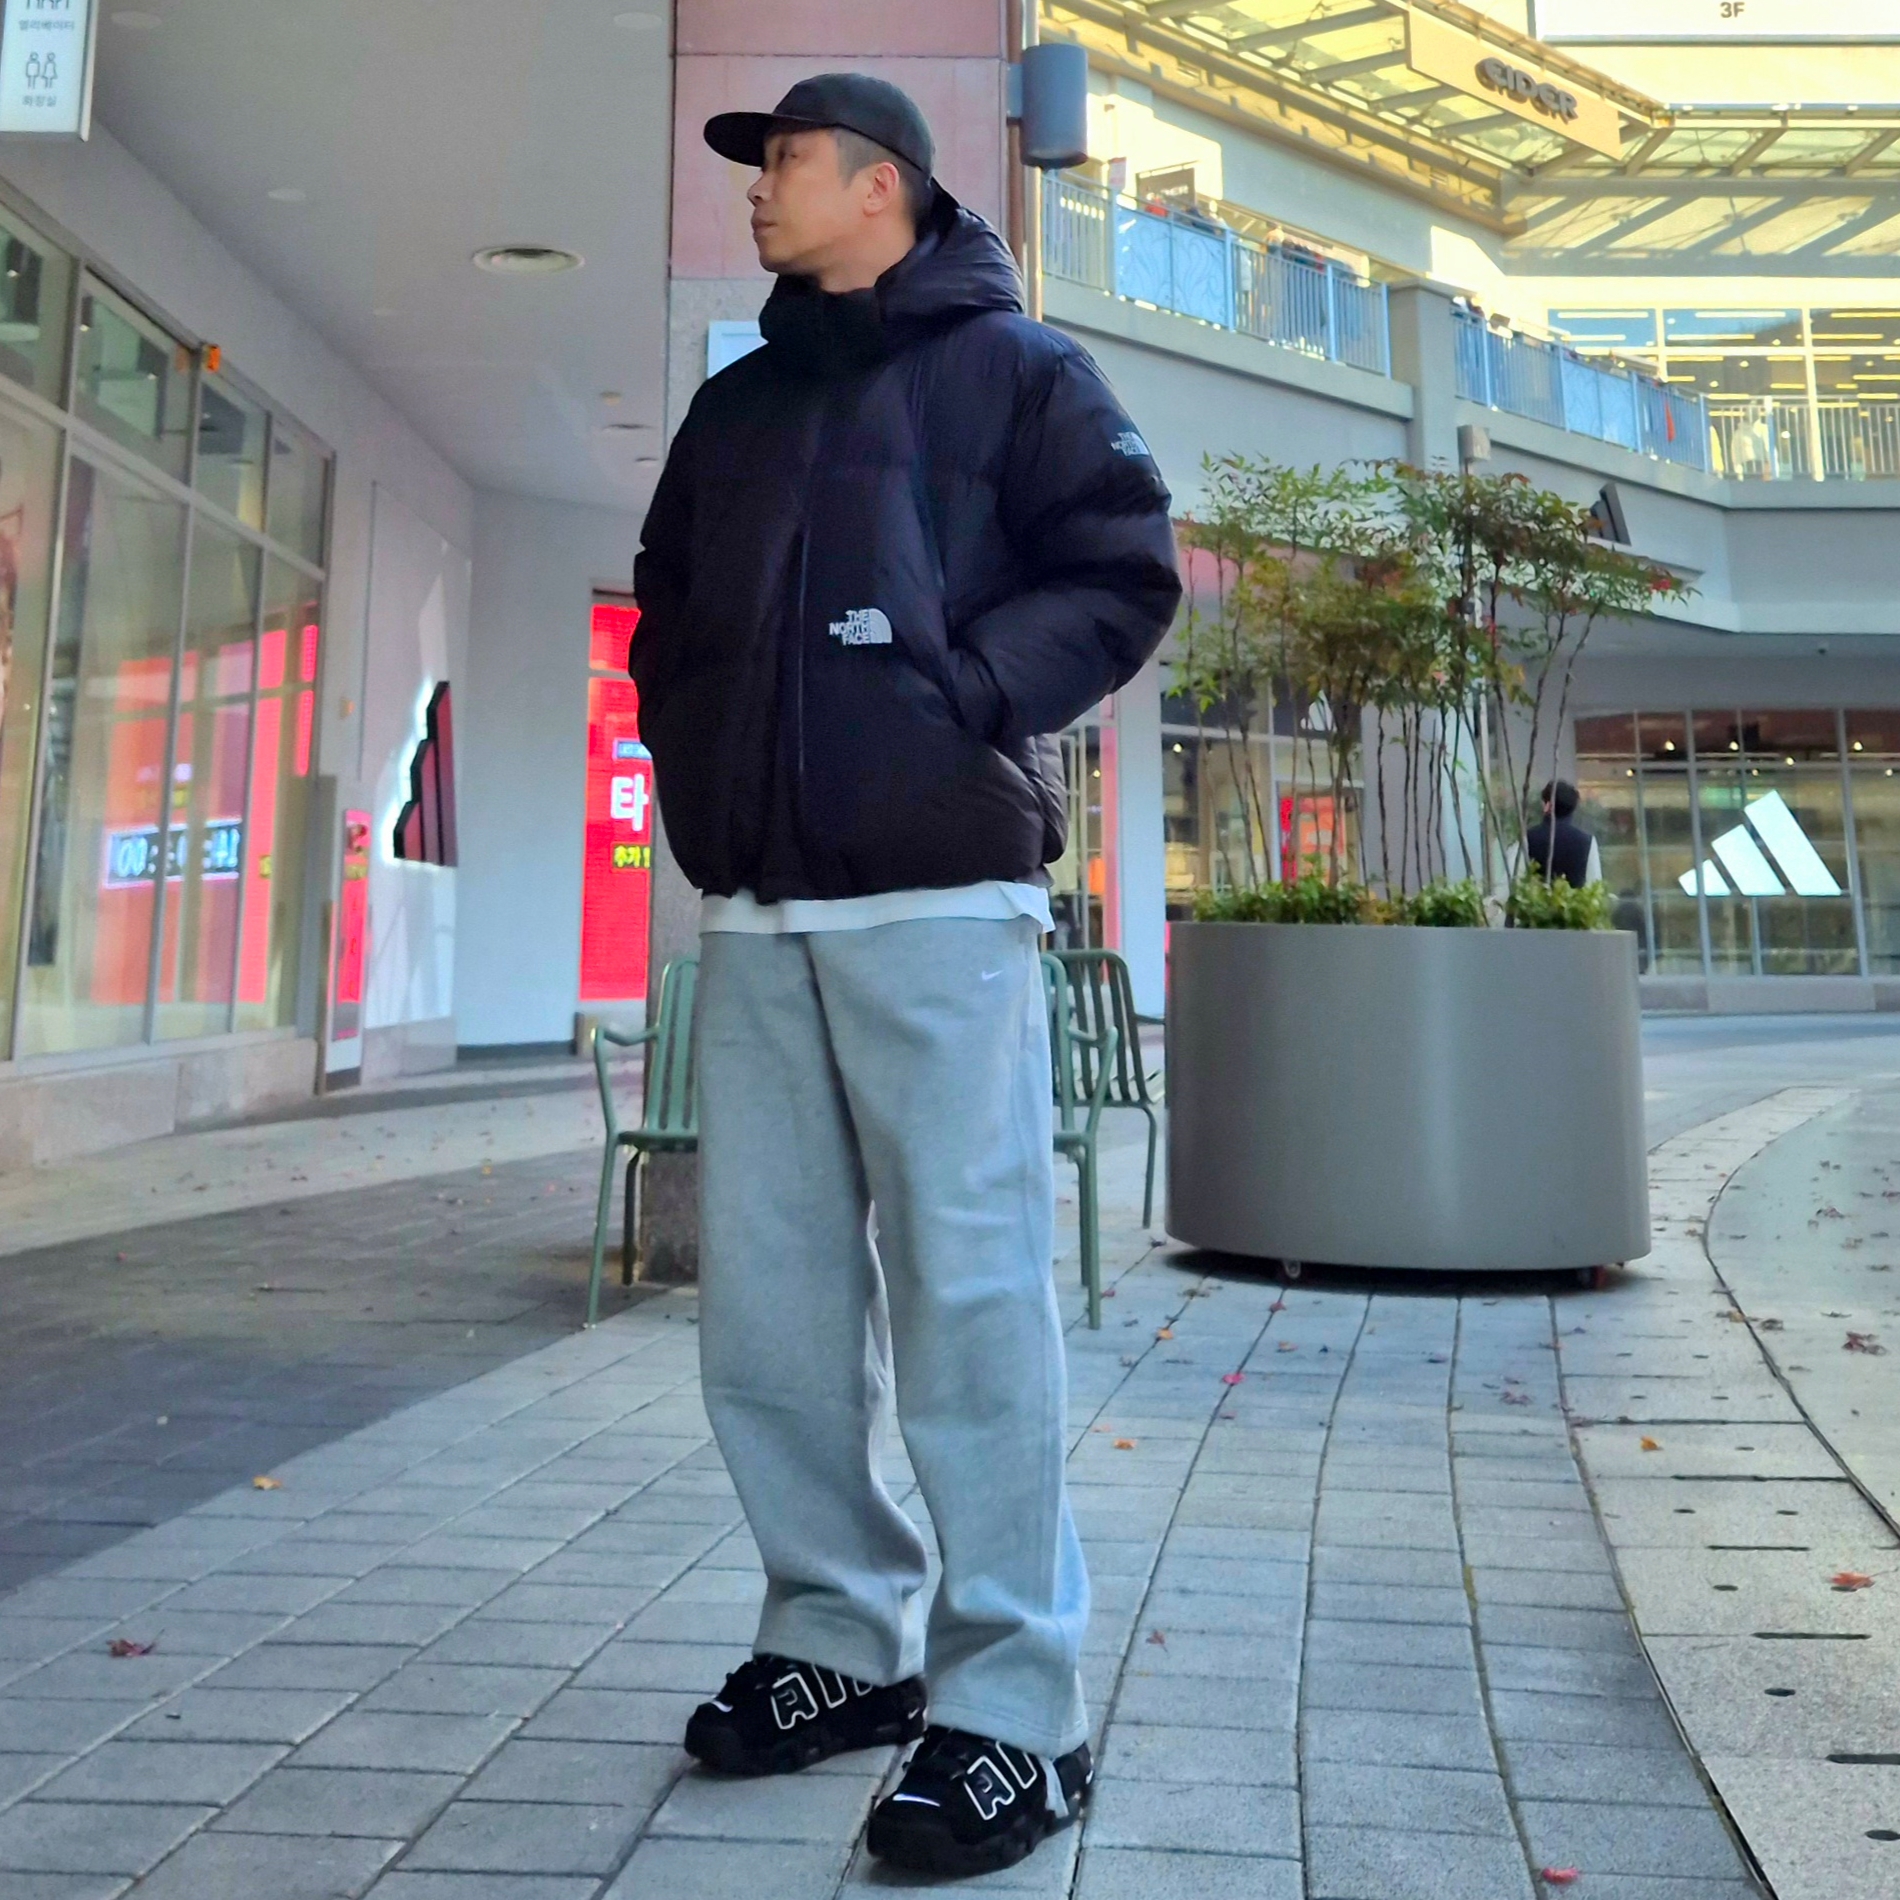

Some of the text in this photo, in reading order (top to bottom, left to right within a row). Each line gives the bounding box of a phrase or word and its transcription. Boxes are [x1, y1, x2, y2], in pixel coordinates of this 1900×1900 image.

[1720, 2, 1745, 18] 3F
[1476, 57, 1579, 123] EIDER
[845, 609, 870, 621] THE
[829, 620, 870, 636] NORTH
[842, 632, 870, 646] FACE
[770, 1663, 873, 1730] AI
